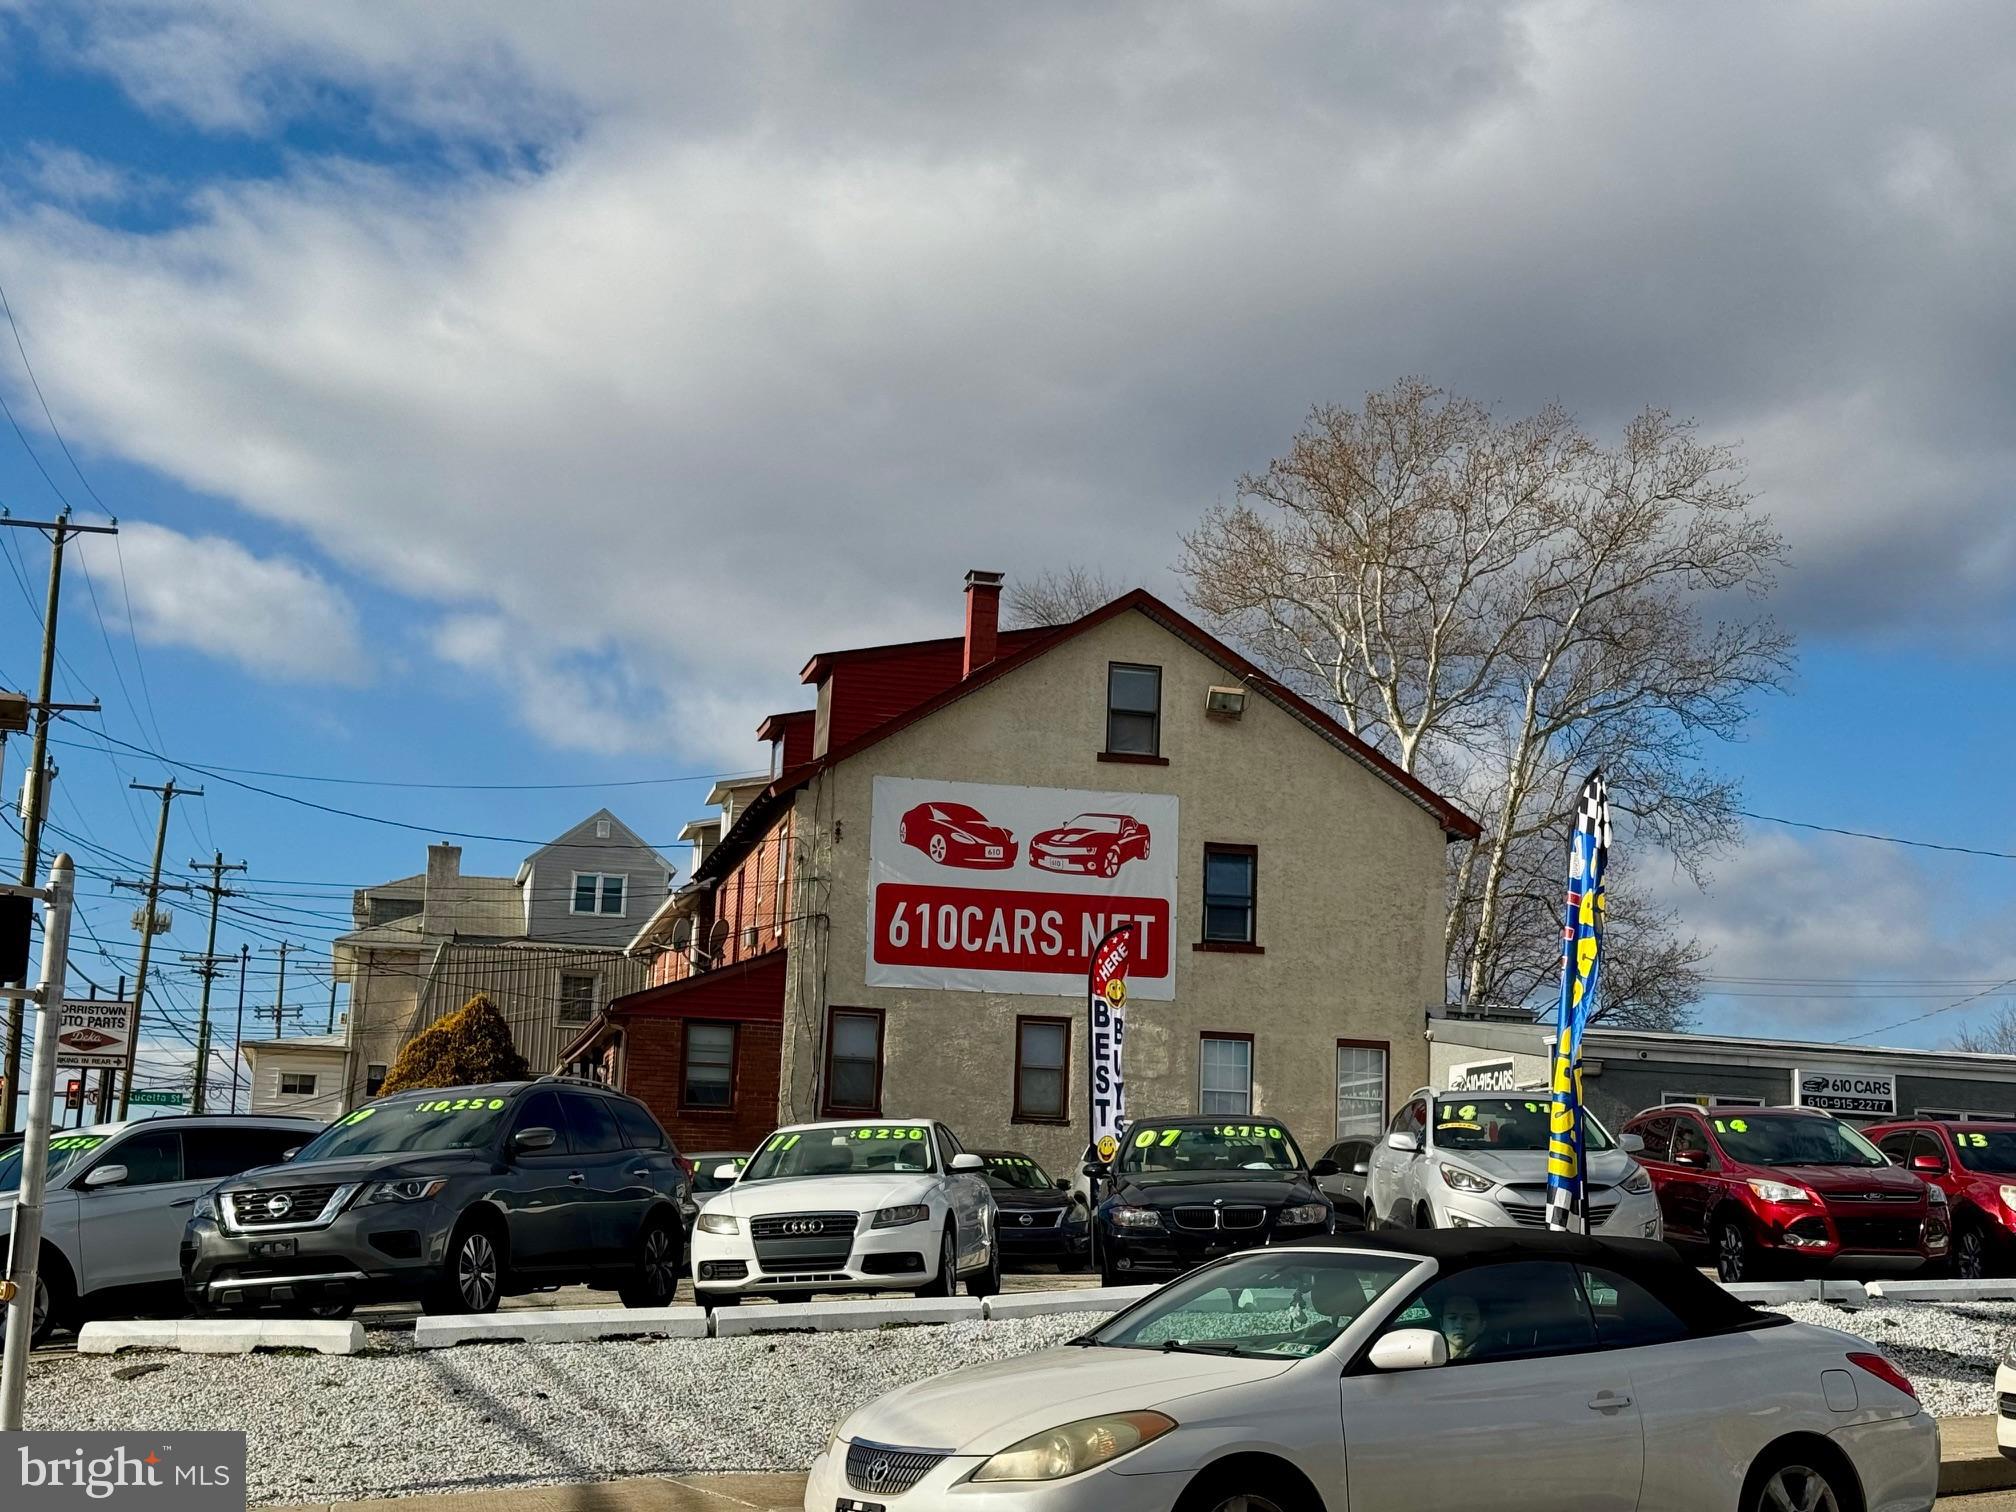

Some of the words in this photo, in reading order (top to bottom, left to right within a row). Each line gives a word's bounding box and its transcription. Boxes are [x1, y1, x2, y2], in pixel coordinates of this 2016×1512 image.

[1099, 942, 1128, 981] HERE
[61, 1004, 127, 1016] ORRISTOWN
[88, 1017, 125, 1029] PARTS
[1094, 1000, 1110, 1127] BEST
[1831, 1079, 1852, 1092] 610
[1854, 1081, 1891, 1095] CARS
[171, 1094, 181, 1103] St
[415, 1098, 504, 1113] $10,250
[1807, 1096, 1887, 1111] 610-915-2277
[333, 1108, 376, 1128] 19
[1442, 1104, 1477, 1120] 14
[849, 1128, 923, 1140] $8250
[1135, 1129, 1183, 1148] 07
[1213, 1126, 1282, 1139] $6750
[1957, 1133, 1989, 1147] 13
[767, 1135, 801, 1151] 11
